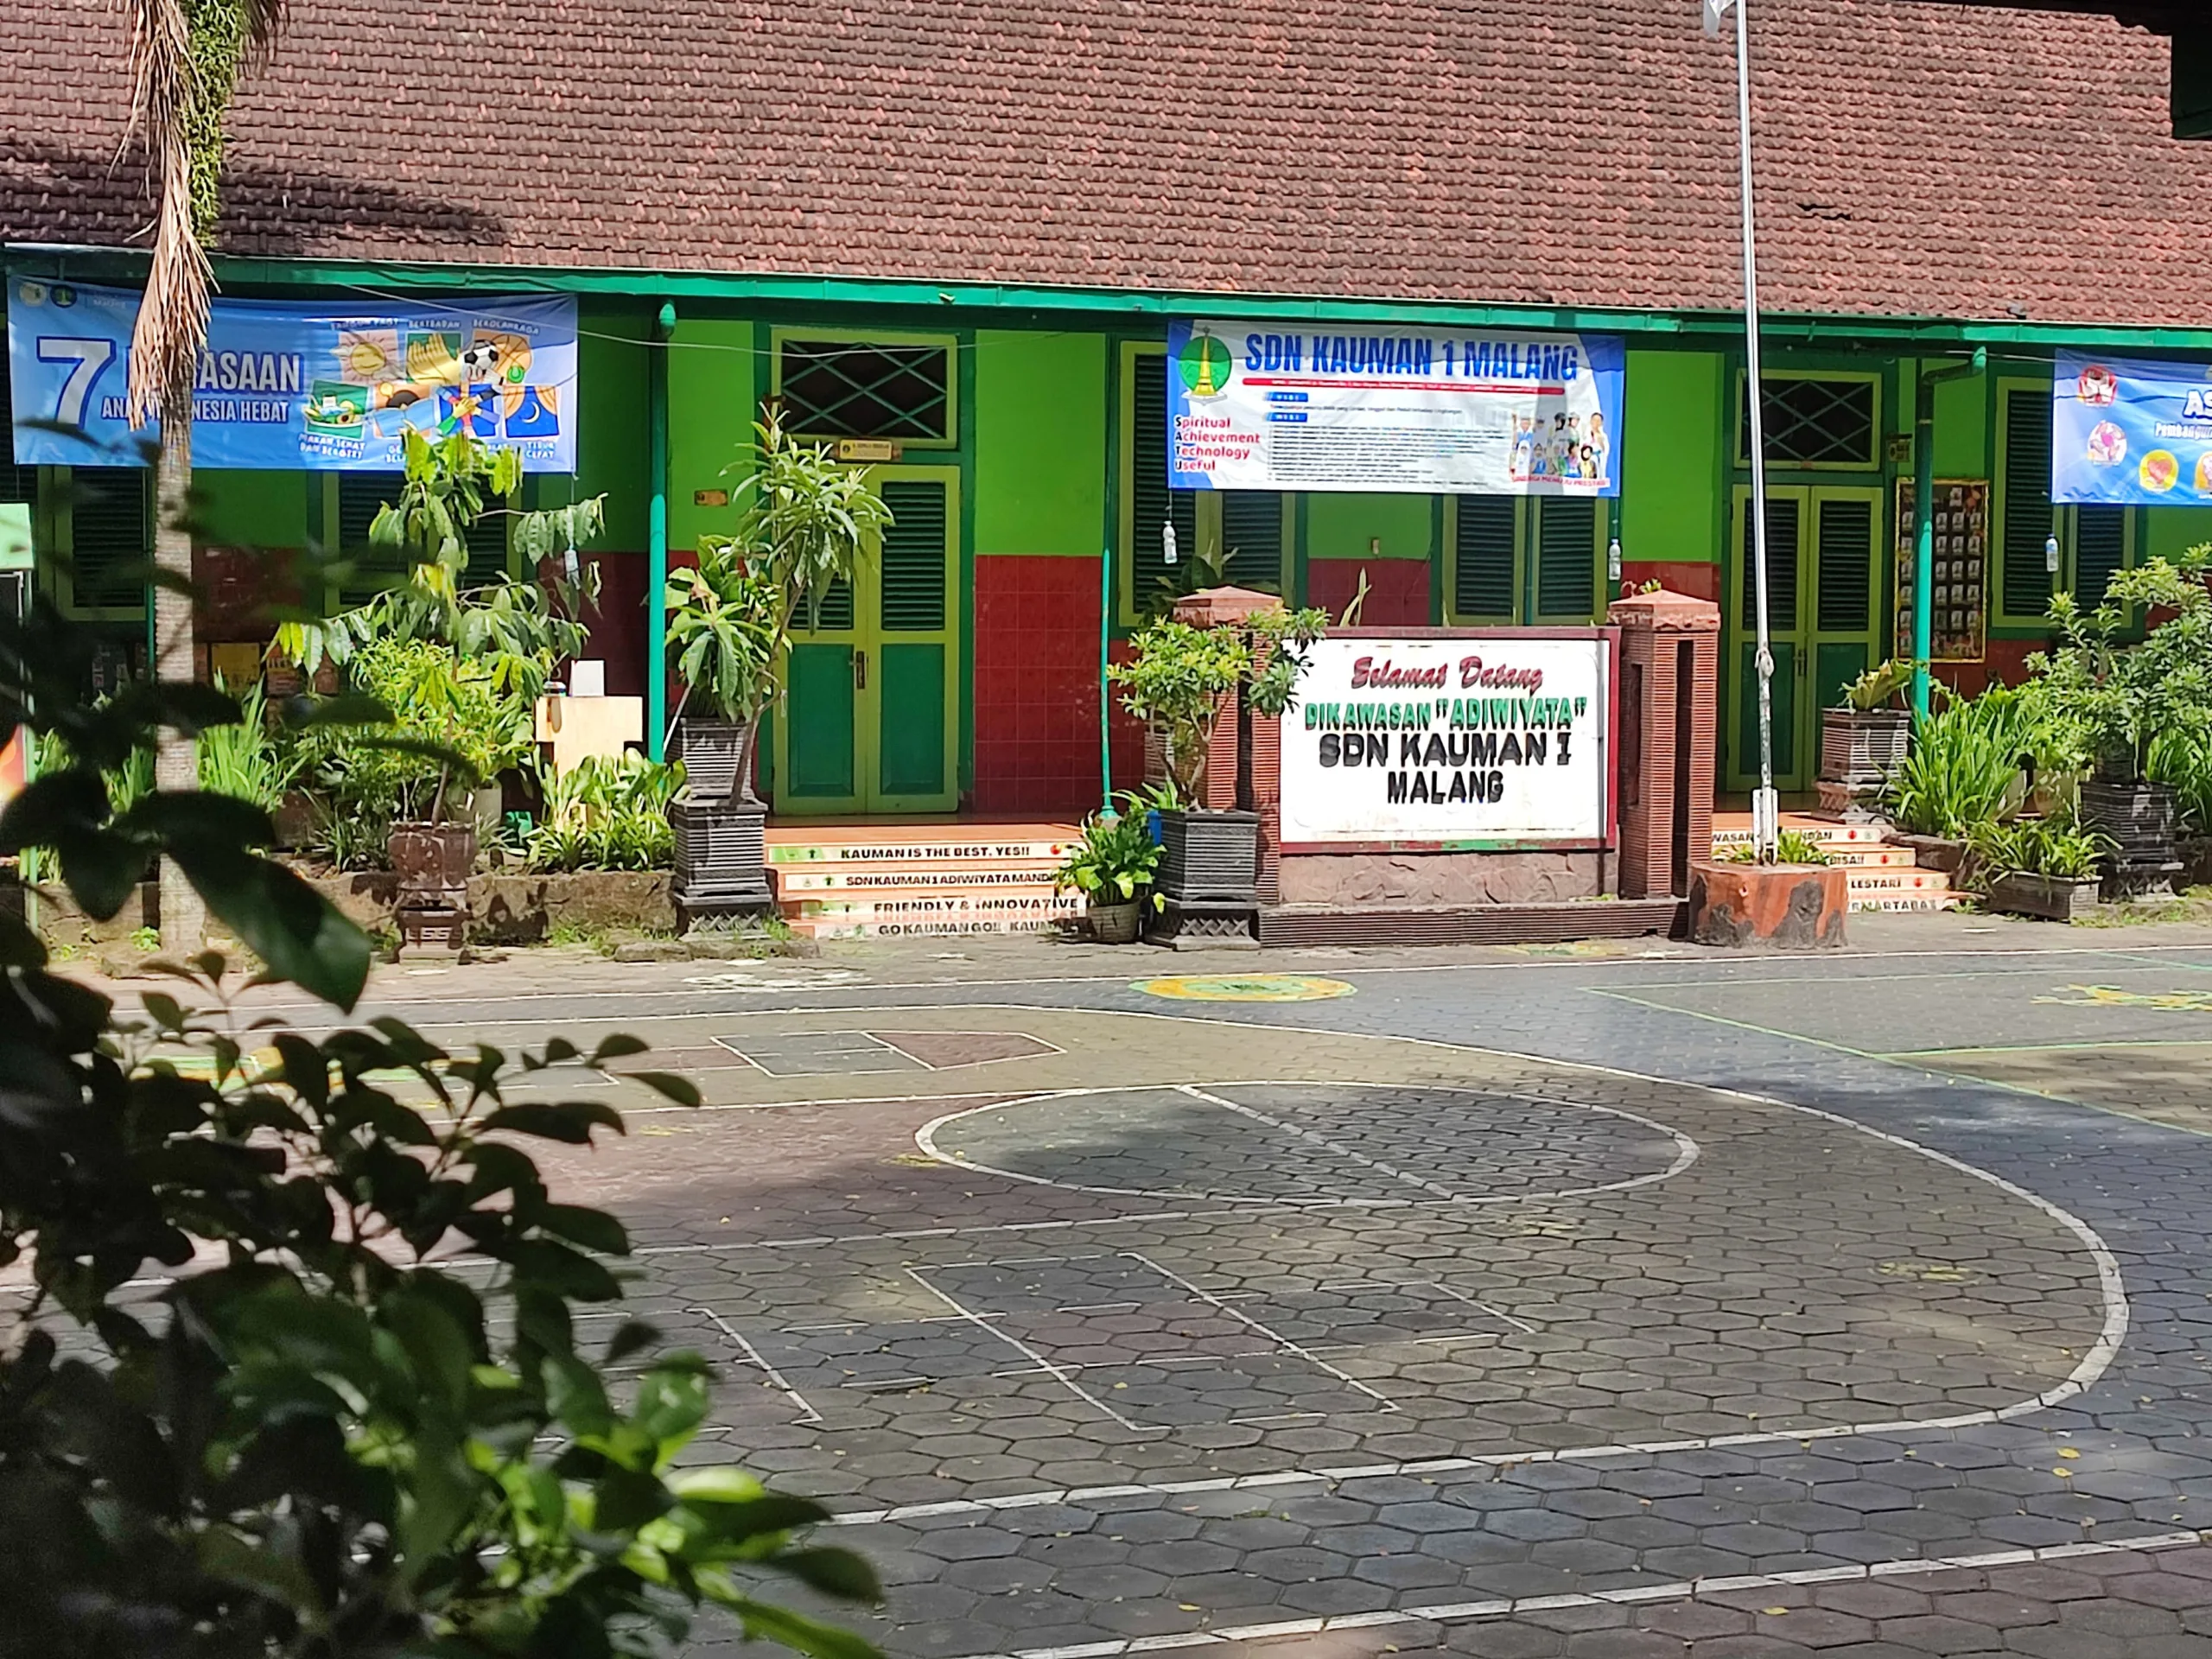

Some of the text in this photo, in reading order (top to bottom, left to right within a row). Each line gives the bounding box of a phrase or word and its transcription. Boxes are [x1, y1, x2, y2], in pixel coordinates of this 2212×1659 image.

[1245, 334, 1578, 380] SDN KAUMAN 1 MALANG
[37, 336, 118, 430] 7
[240, 399, 289, 423] HEBAT
[1175, 416, 1230, 429] Spiritual
[1175, 430, 1261, 443] Achievement
[1175, 445, 1250, 460] Technology
[1175, 460, 1216, 471] Useful
[1351, 656, 1543, 697] Selamat Datang
[1305, 697, 1587, 731] DIKAWASAN "ADIWIYATA"
[1319, 733, 1389, 768] SDN
[1401, 732, 1548, 767] KAUMAN
[1388, 770, 1504, 804] MALANG
[841, 849, 905, 859] KAUMAN
[908, 848, 922, 857] IS
[925, 848, 950, 857] THE
[995, 846, 1030, 856] YES!!
[846, 876, 873, 886] SDN
[874, 875, 931, 886] KAUMAN
[1851, 877, 1902, 888] LESTARI
[874, 901, 955, 912] FRIENDLY
[879, 924, 901, 935] GO
[903, 922, 969, 934] KAUMAN
